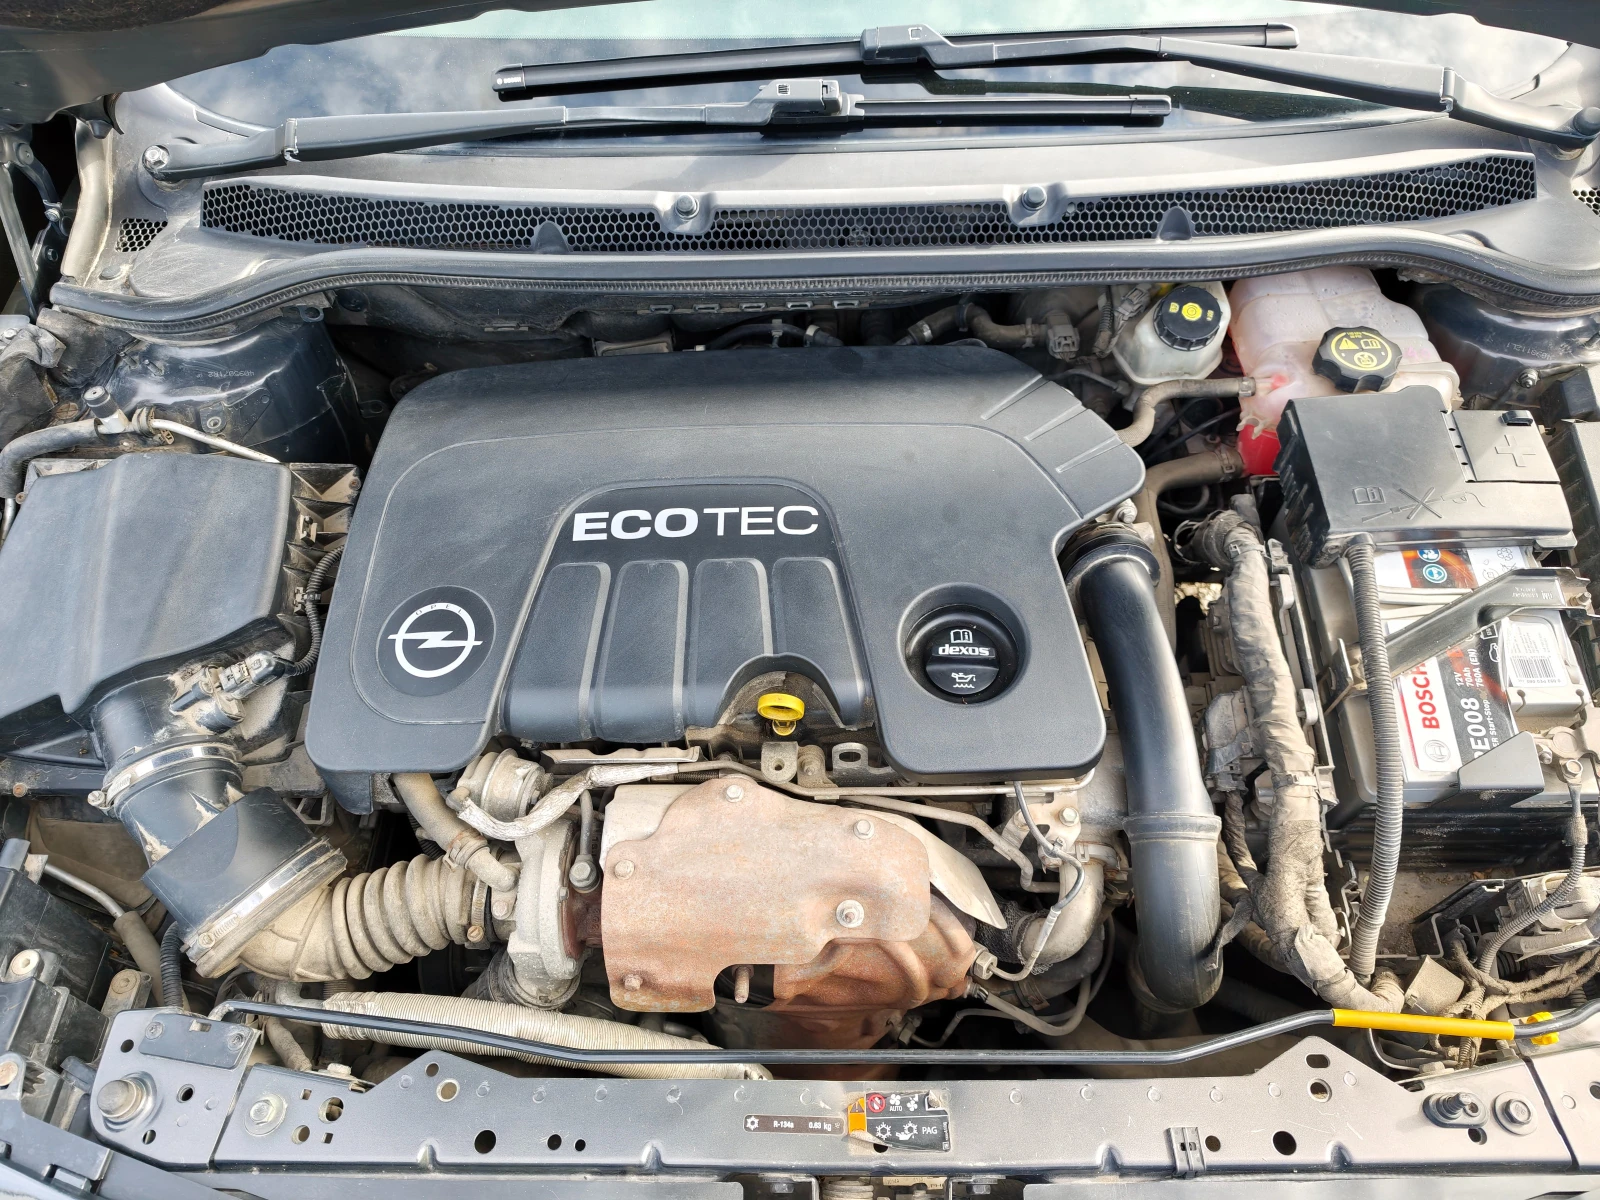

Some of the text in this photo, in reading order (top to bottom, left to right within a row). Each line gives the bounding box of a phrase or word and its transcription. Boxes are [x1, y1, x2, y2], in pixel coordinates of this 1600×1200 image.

[572, 505, 819, 541] ECOTEC
[415, 604, 463, 616] OPEL
[938, 643, 990, 656] dexos
[1467, 648, 1485, 688] 760A (EN)
[1454, 671, 1464, 687] 12V
[1462, 667, 1474, 688] 70Ah
[1482, 699, 1498, 739] Start-Stop
[773, 1120, 795, 1129] R-134a
[823, 1122, 832, 1132] kg
[922, 1126, 938, 1135] PAG
